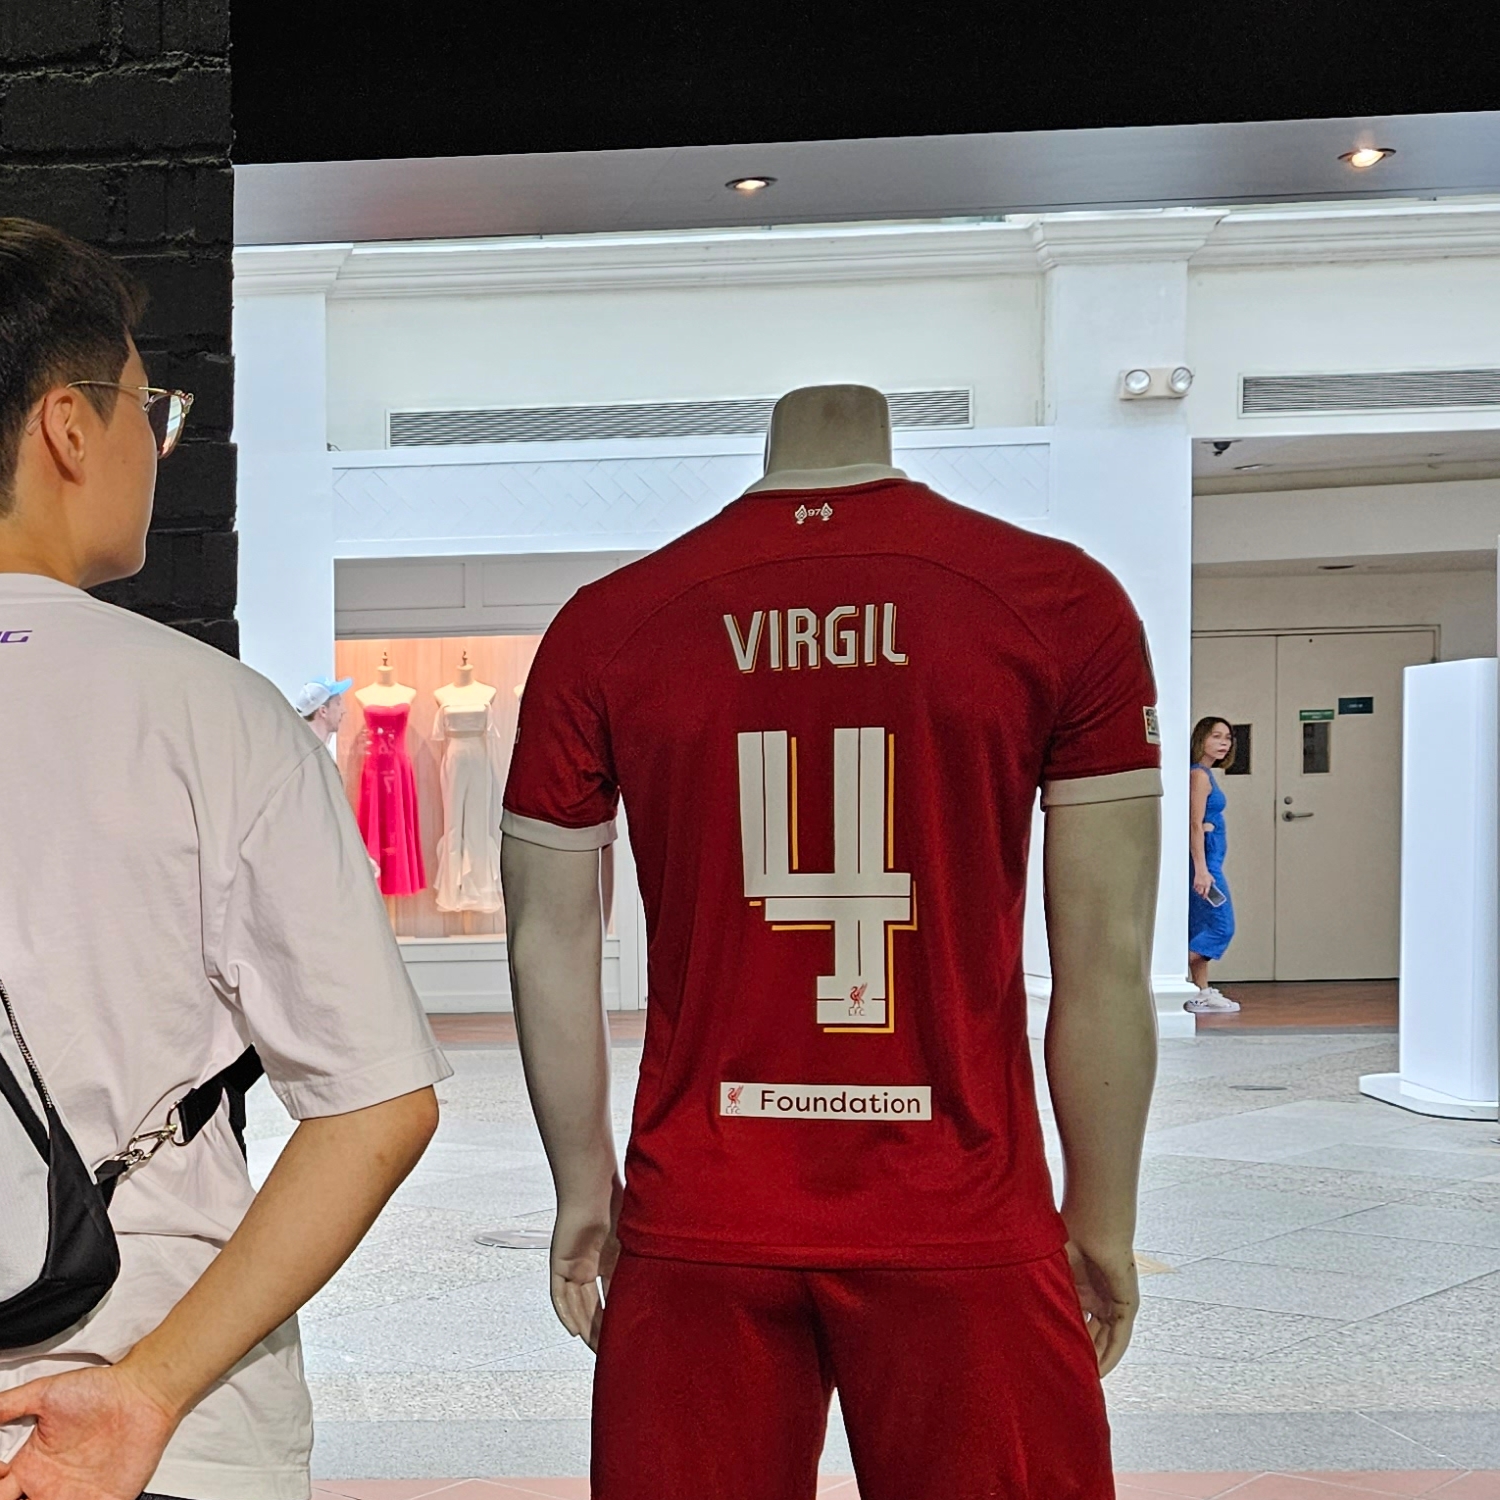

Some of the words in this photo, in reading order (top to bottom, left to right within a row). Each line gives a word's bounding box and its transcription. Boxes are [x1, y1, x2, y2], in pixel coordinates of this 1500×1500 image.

[723, 602, 909, 674] VIRGIL
[737, 727, 918, 1034] 4
[761, 1090, 921, 1114] Foundation
